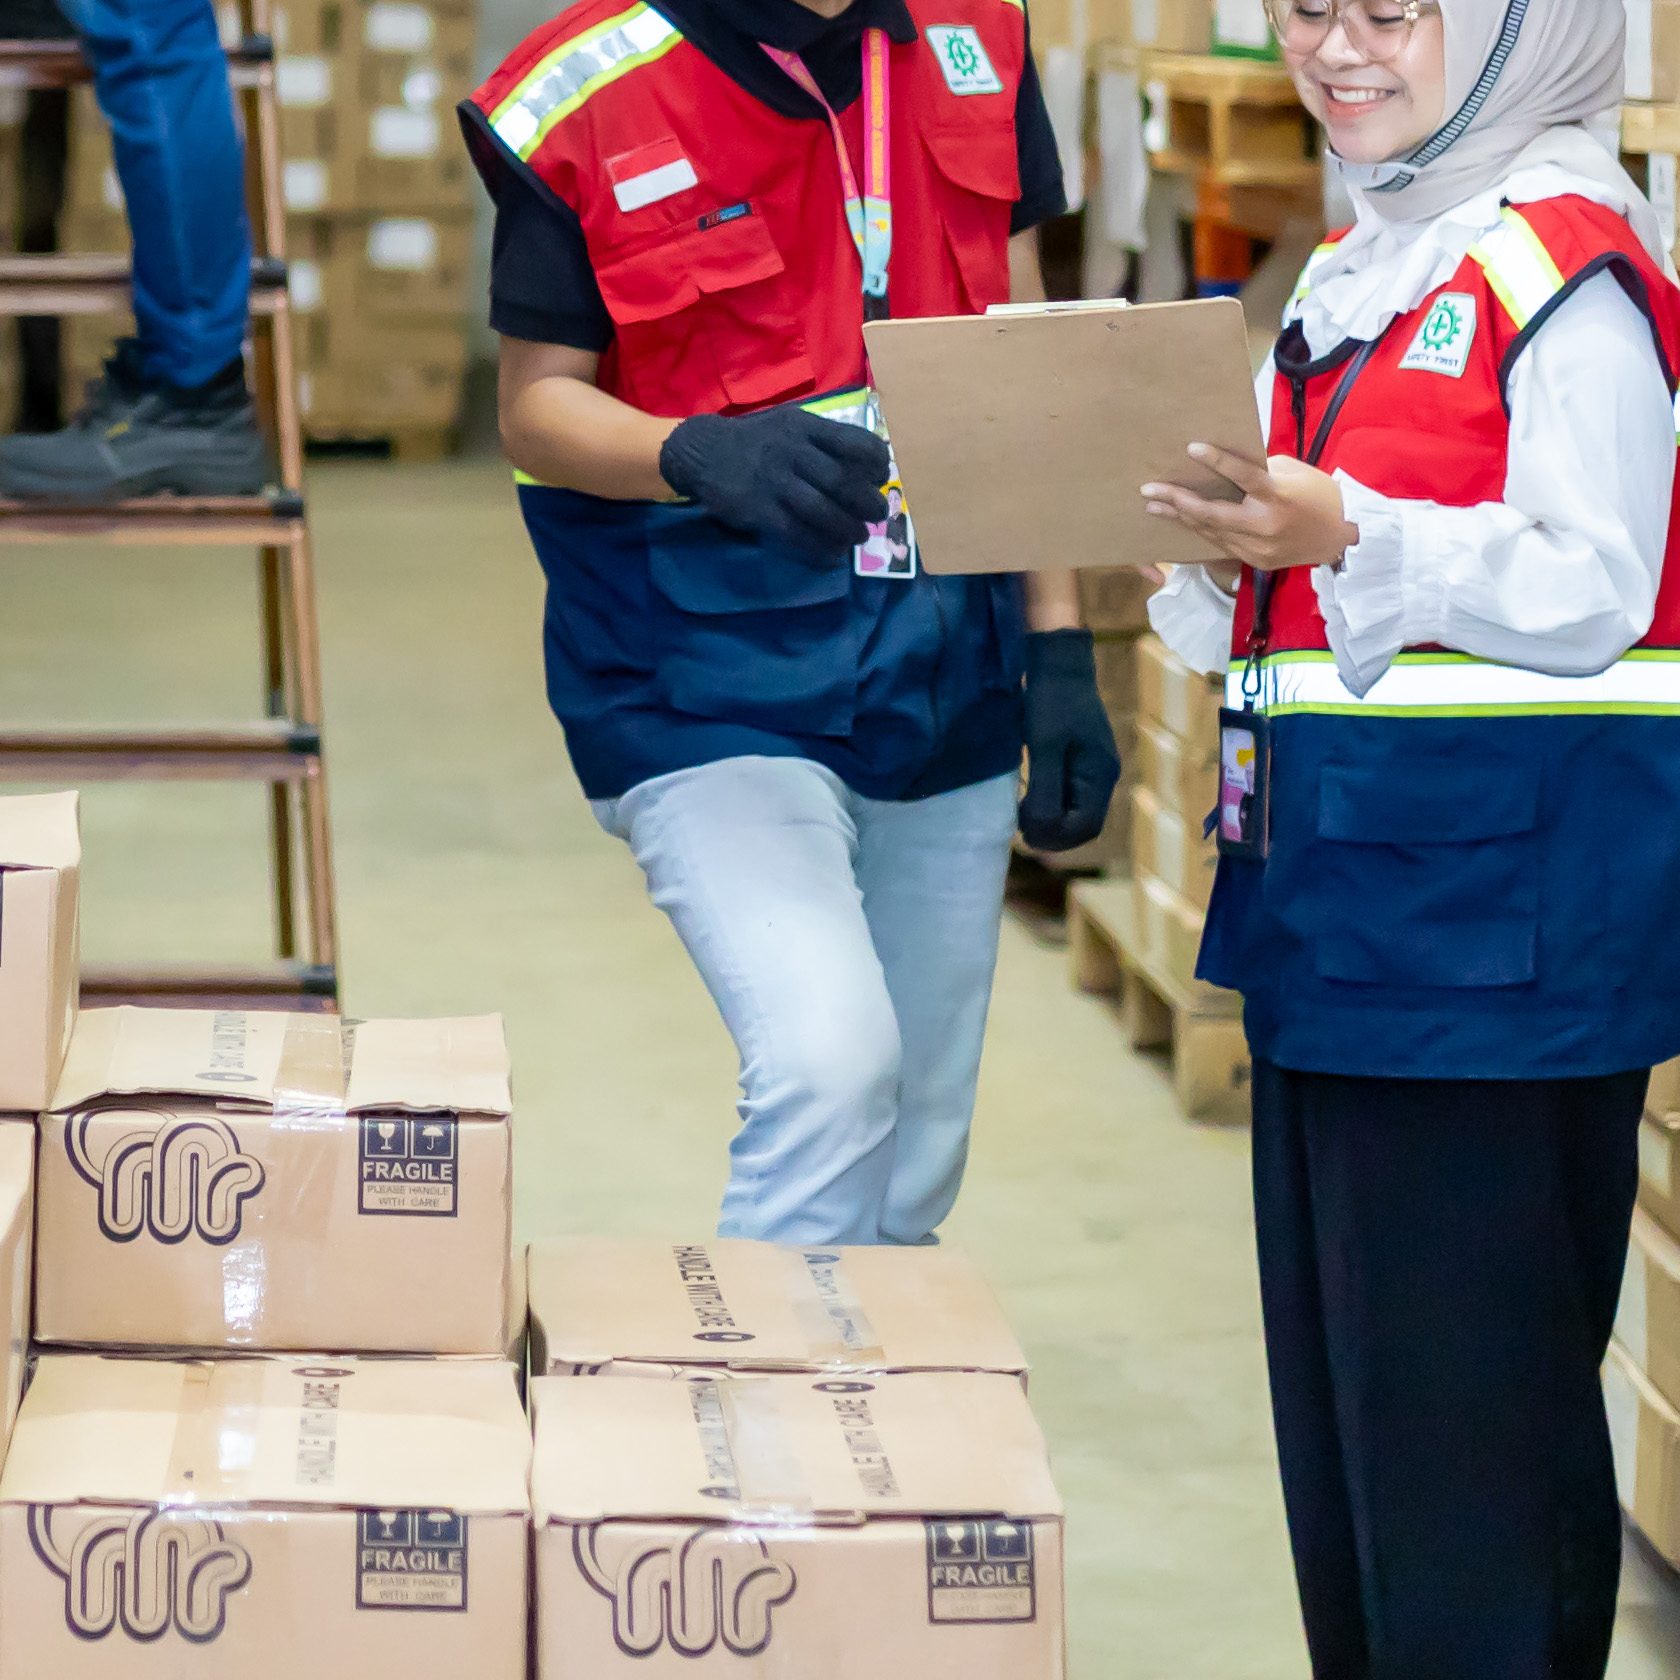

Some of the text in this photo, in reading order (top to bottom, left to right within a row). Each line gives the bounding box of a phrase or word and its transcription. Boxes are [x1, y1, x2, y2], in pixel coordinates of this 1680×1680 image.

[363, 1161, 453, 1181] FRAGILE
[367, 1184, 450, 1197] PLEASE HANDLE
[379, 1197, 439, 1209] WITH CARE
[671, 1245, 736, 1327] HANDLE WITH CARE
[832, 1399, 874, 1427] CARE
[362, 1550, 461, 1572] FRAGILE
[366, 1576, 457, 1589] PLEASE HANDLE
[932, 1564, 1031, 1587] FRAGILE
[380, 1589, 447, 1603] WITH CARE
